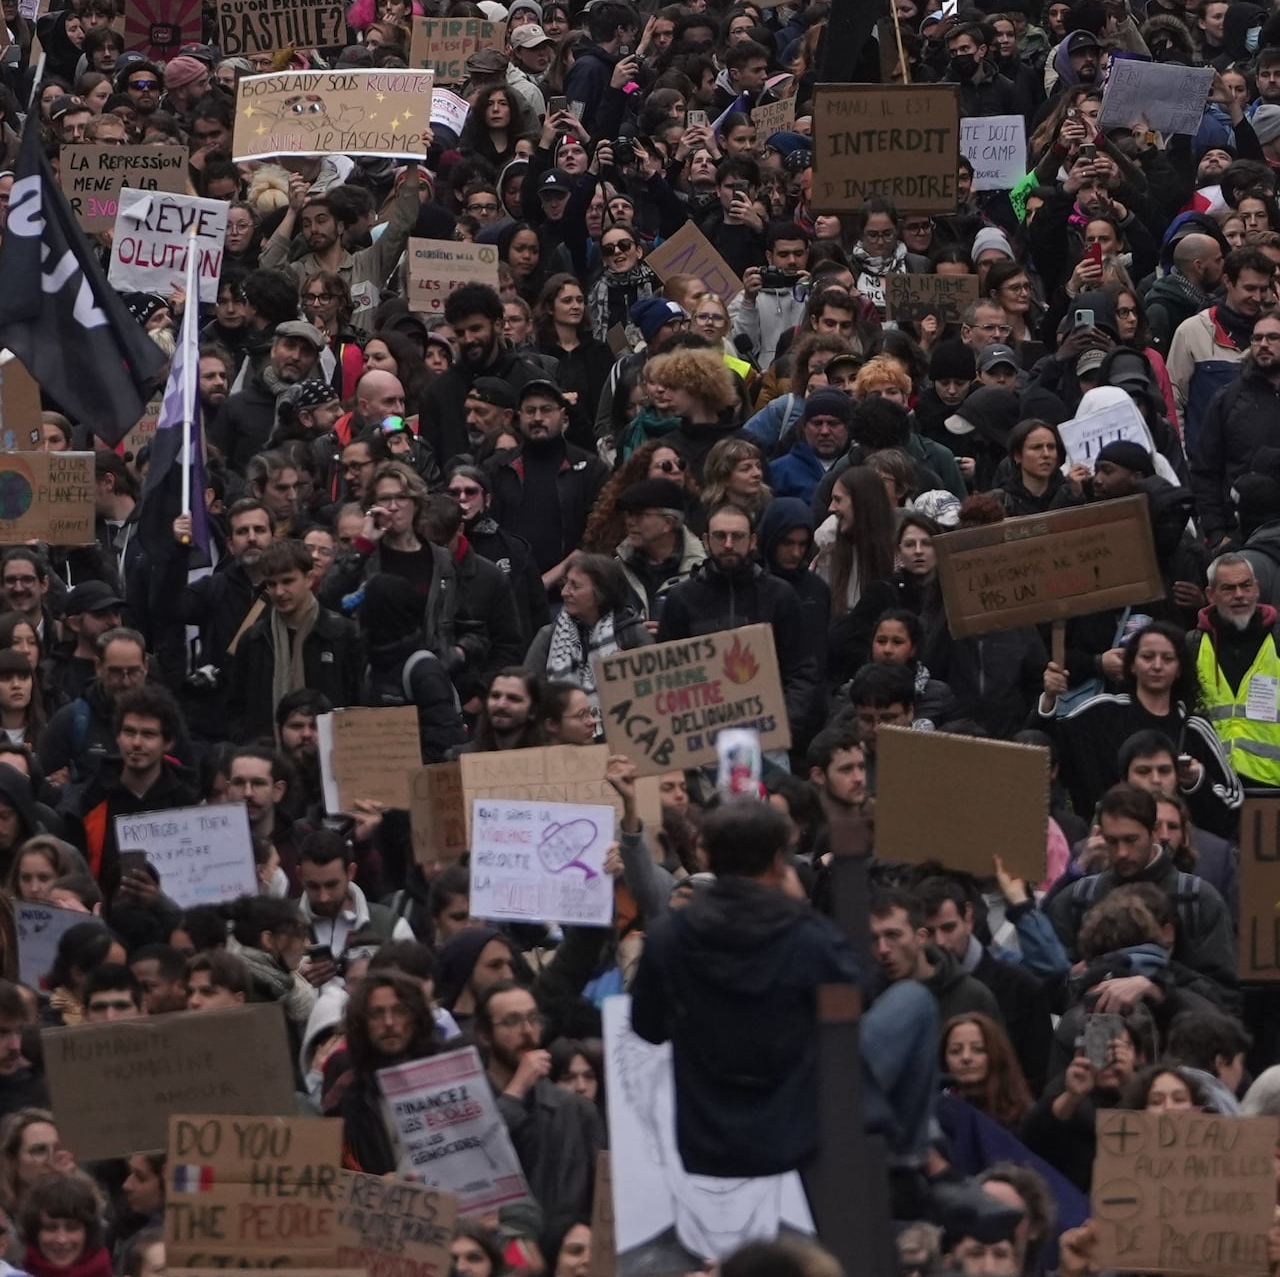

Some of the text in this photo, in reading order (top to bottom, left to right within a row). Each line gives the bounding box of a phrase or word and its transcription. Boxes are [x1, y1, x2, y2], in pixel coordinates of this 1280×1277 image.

[221, 0, 270, 15] QU'ON
[421, 21, 496, 38] TIRER
[325, 73, 359, 93] SOUS
[880, 98, 895, 117] IL
[905, 96, 932, 115] EST
[827, 127, 950, 158] INTERDIT
[989, 125, 1019, 142] DOIT
[72, 154, 91, 170] LA
[983, 145, 1017, 162] CAMP
[418, 279, 441, 291] LES
[609, 698, 677, 765] ACAB
[175, 1120, 291, 1158] DO YOU
[249, 1164, 339, 1201] HEAR
[167, 1204, 335, 1241] THE PEOPLE
